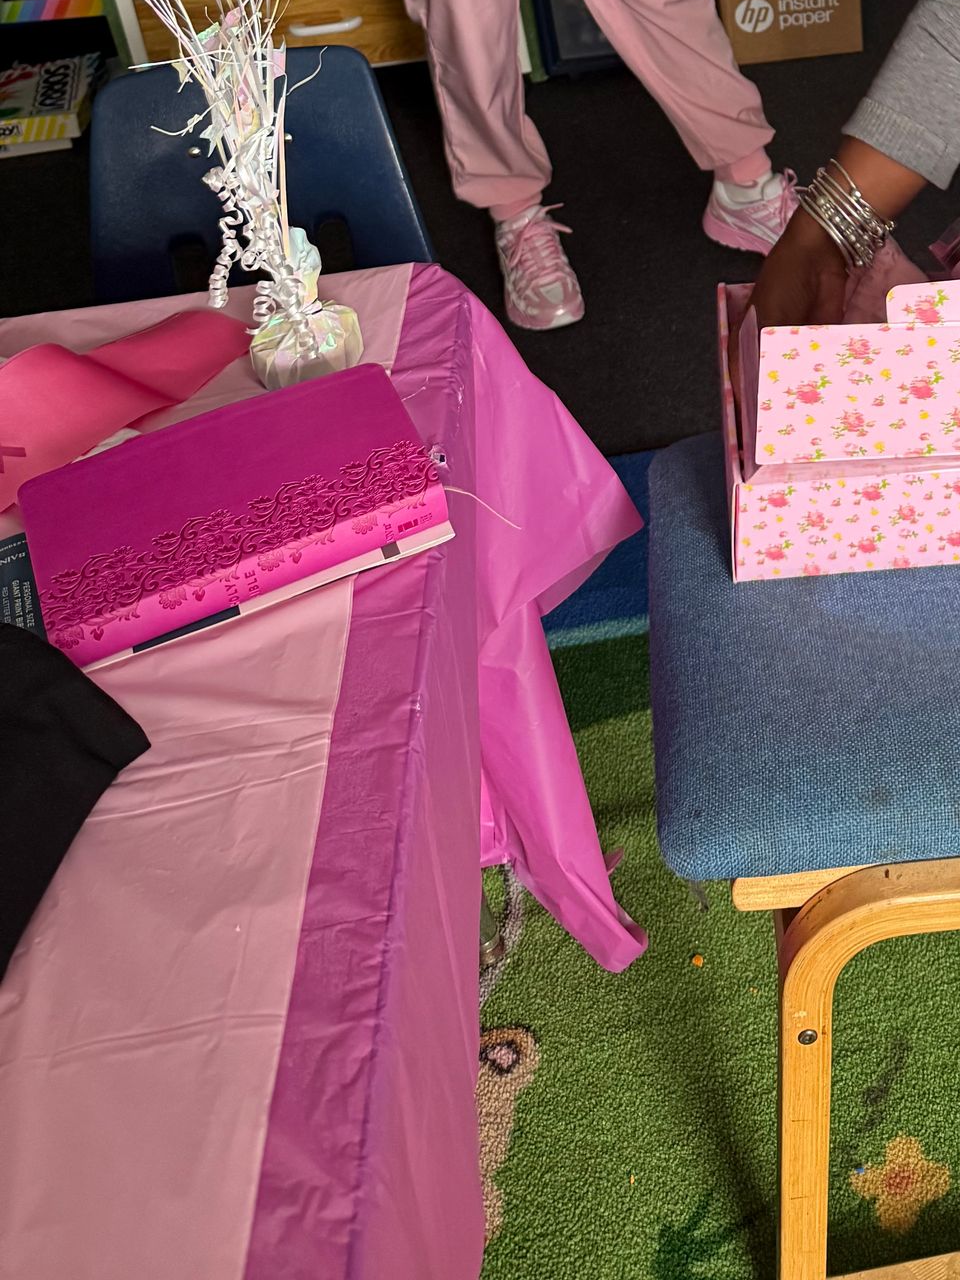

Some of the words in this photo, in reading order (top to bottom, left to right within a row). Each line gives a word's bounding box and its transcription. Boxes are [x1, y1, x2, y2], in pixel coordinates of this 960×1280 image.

[778, 8, 835, 31] paper
[244, 569, 262, 598] IBLE
[26, 613, 36, 628] SIZE
